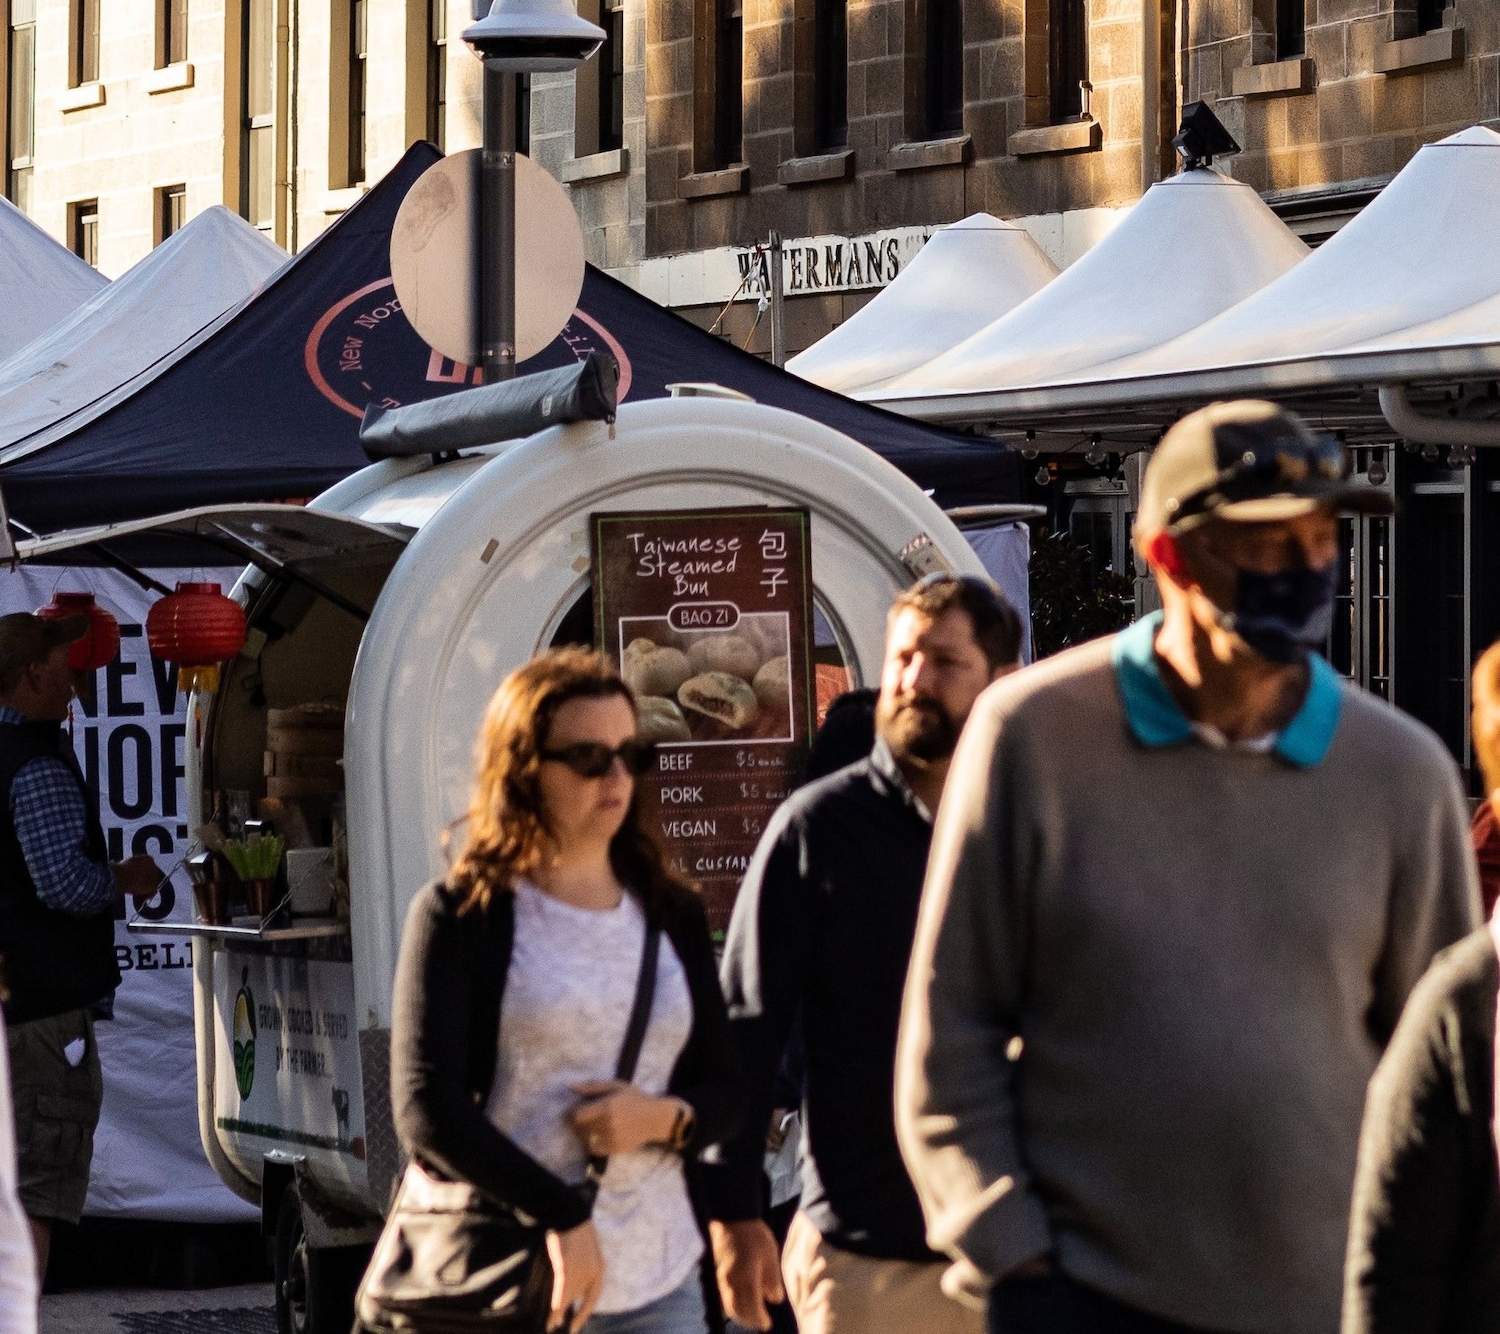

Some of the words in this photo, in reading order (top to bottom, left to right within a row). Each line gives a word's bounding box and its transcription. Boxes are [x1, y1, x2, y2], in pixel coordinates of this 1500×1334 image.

[339, 336, 363, 372] New
[626, 533, 742, 555] Taiwanese
[636, 552, 738, 578] Steamed
[758, 528, 789, 598] 包子
[672, 573, 709, 597] Bun
[680, 610, 711, 626] BAO
[715, 609, 729, 624] ZI
[659, 753, 693, 771] BEEF
[661, 787, 704, 804] PORK
[661, 820, 717, 837] VEGAN
